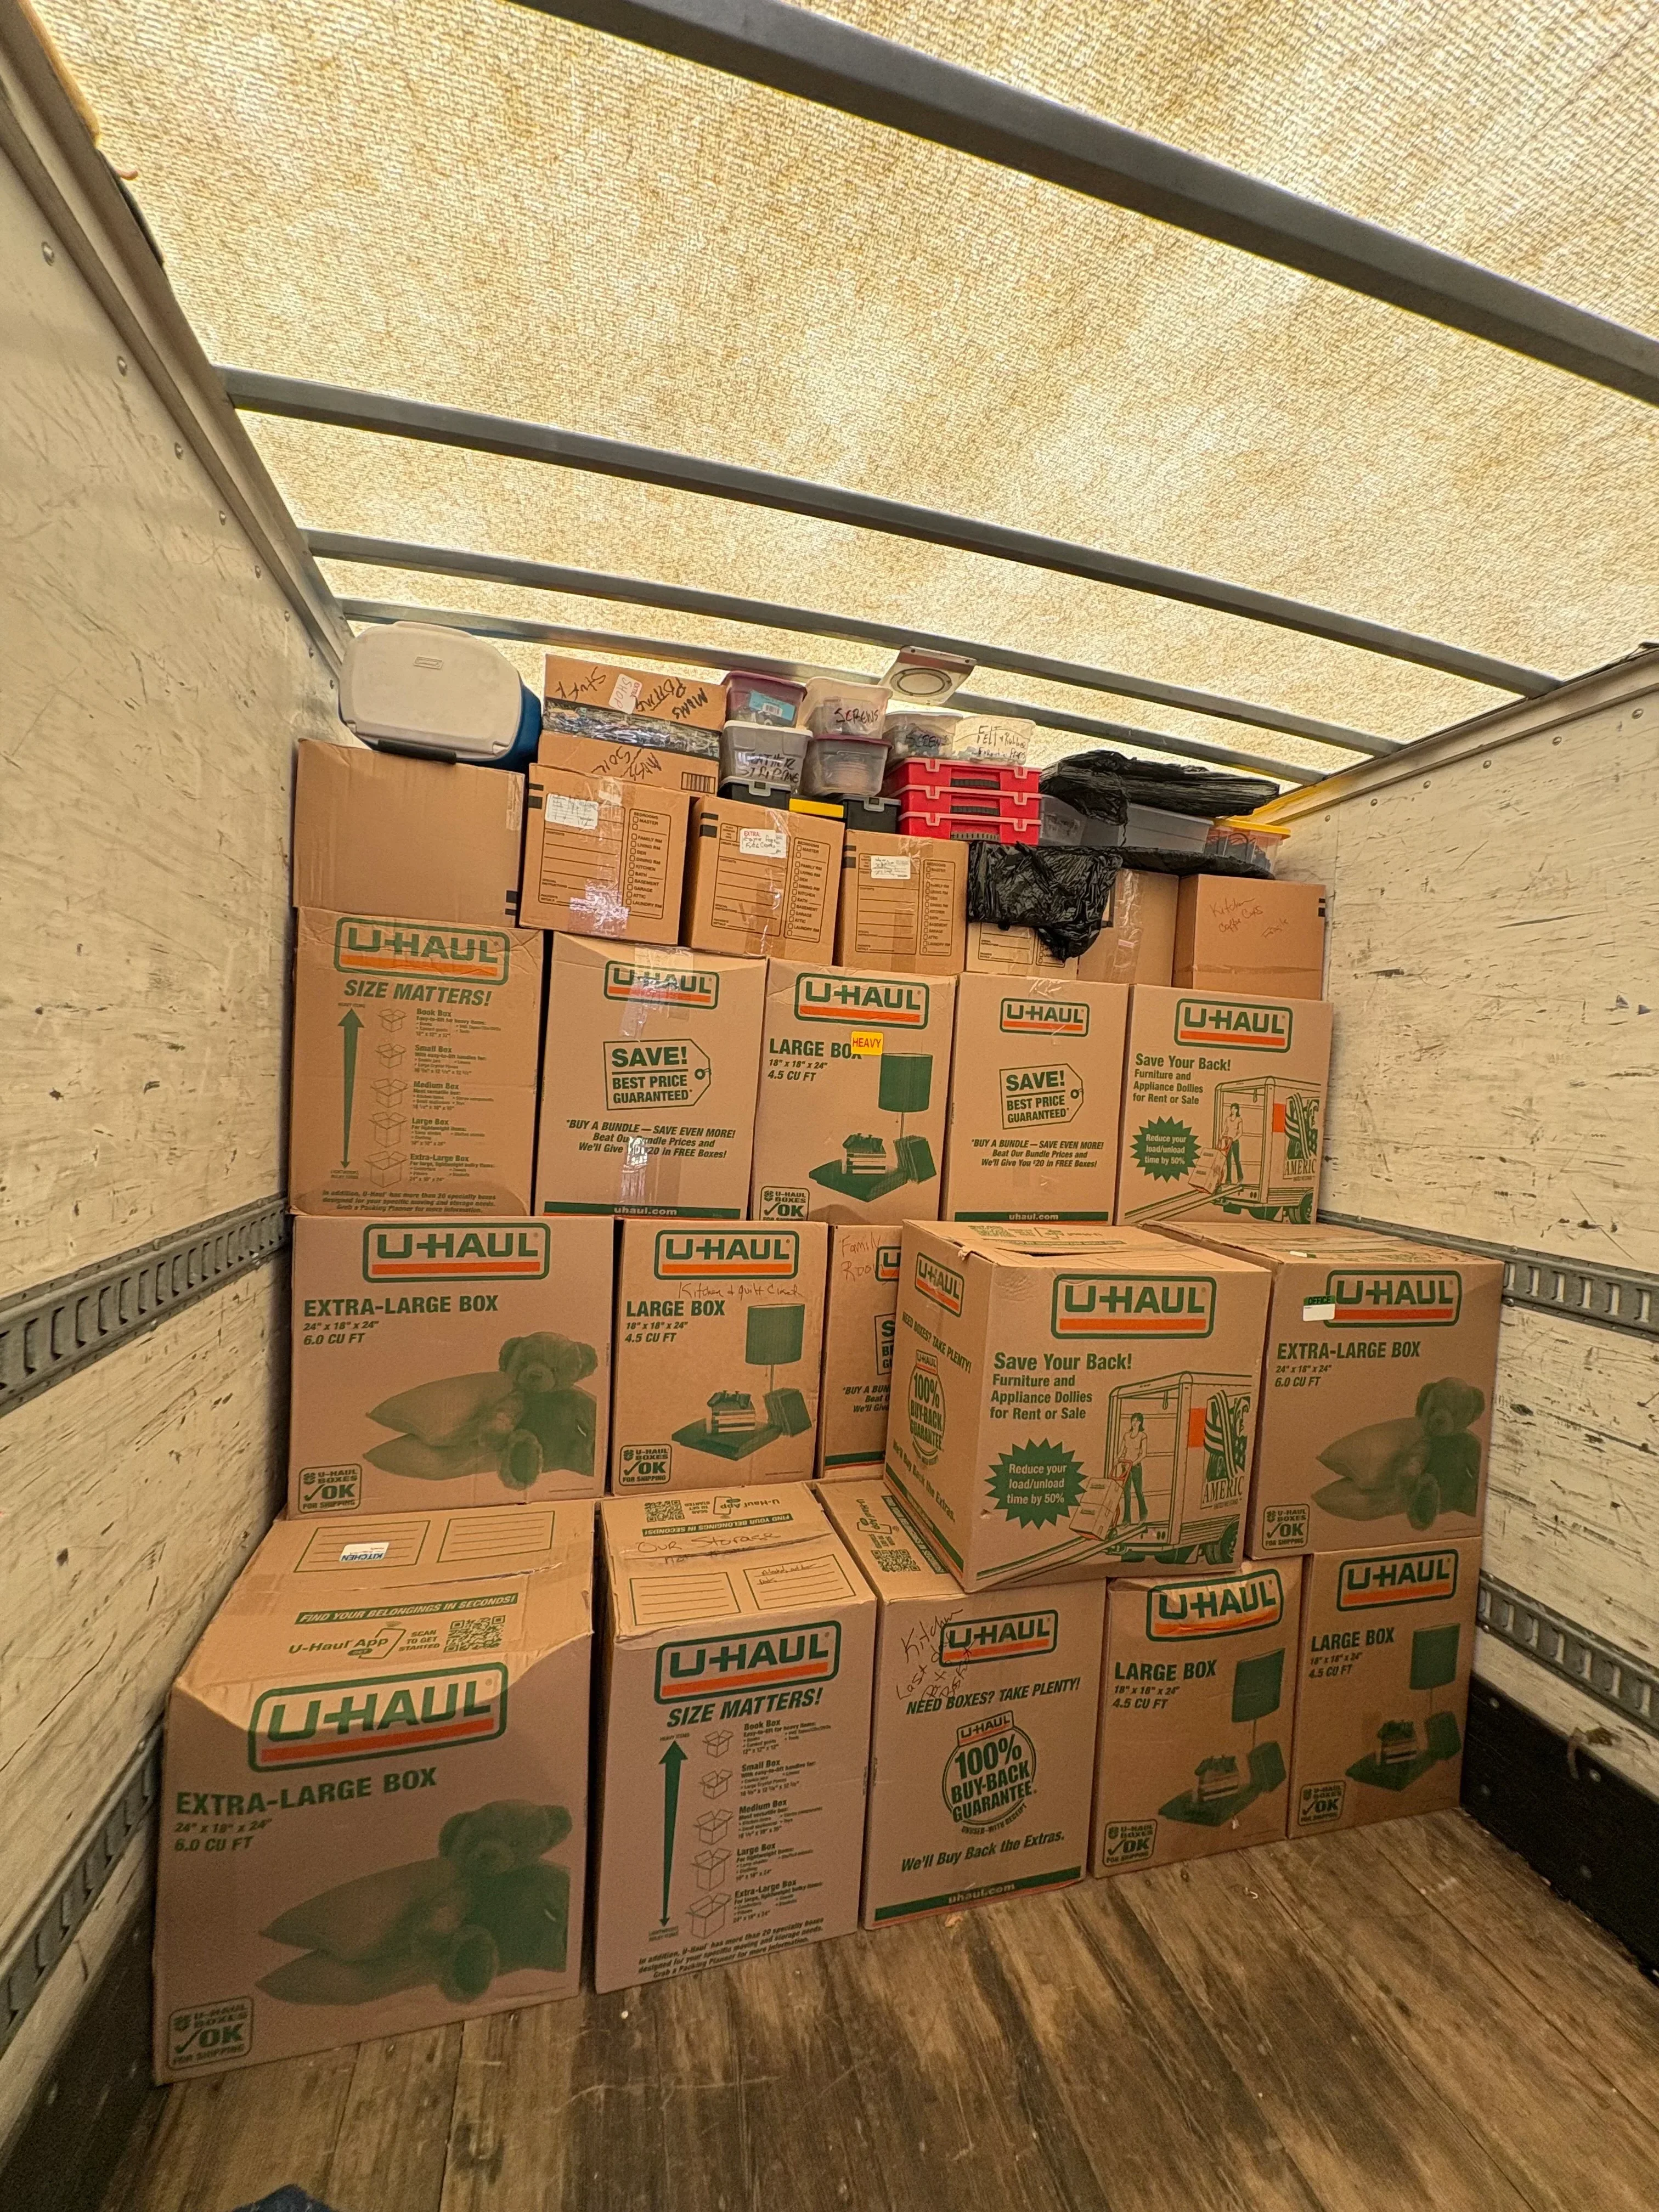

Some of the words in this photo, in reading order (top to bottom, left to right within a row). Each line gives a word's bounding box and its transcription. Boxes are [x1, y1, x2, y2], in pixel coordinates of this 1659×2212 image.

[834, 708, 878, 723] SCREWS
[348, 927, 498, 963] U-HAUL
[344, 980, 388, 997] SIZE
[393, 983, 492, 1006] MATTERS!
[805, 981, 920, 1010] U-HAUL
[1007, 1004, 1083, 1023] U-HAUL
[1184, 1007, 1284, 1034] U-HAUL
[770, 1039, 824, 1057] LARGE
[853, 1036, 882, 1048] HEAVY
[612, 1047, 687, 1067] SAVE!
[1136, 1053, 1164, 1066] Save
[1169, 1056, 1194, 1069] Your
[1199, 1058, 1231, 1071] Back!
[612, 1077, 645, 1089] BEST
[650, 1075, 687, 1087] PRICE
[1006, 1070, 1064, 1091] SAVE!
[1007, 1098, 1032, 1110] BEST
[1036, 1095, 1064, 1107] PRICE
[412, 1118, 432, 1126] Large
[410, 1154, 452, 1165] Extra-Large
[614, 1206, 676, 1215] uhaul.com
[377, 1233, 538, 1259] U-HAUL
[666, 1239, 789, 1260] U-HAUL
[918, 1260, 959, 1299] U-HAUL
[1065, 1285, 1205, 1313] U-HAUL
[1308, 1296, 1331, 1305] OFFICE
[1335, 1280, 1453, 1305] U-HAUL
[304, 1296, 450, 1317] EXTRA-LARGE
[460, 1295, 498, 1311] BOX
[627, 1301, 684, 1317] LARGE
[691, 1300, 725, 1316] BOX
[304, 1335, 324, 1345] 6.0
[328, 1334, 345, 1344] CU
[349, 1333, 365, 1343] FT
[1277, 1342, 1386, 1359] EXTRA-LARGE
[1391, 1341, 1420, 1357] BOX
[994, 1352, 1037, 1370] Save
[1043, 1354, 1080, 1370] Your
[1087, 1353, 1131, 1369] Back!
[993, 1374, 1049, 1387] Furniture
[1054, 1375, 1075, 1386] and
[991, 1390, 1051, 1405] Appliance
[1055, 1391, 1092, 1402] Dollies
[990, 1407, 1008, 1418] for
[1013, 1408, 1041, 1420] Rent
[1045, 1410, 1057, 1419] or
[1061, 1408, 1086, 1419] Sale
[318, 1469, 357, 1477] U-HAUL
[318, 1475, 357, 1483] BOXES
[1009, 1464, 1044, 1474] Reduce
[1047, 1465, 1066, 1475] your
[321, 1483, 354, 1499] OK
[1009, 1478, 1064, 1489] load/unload
[319, 1499, 355, 1508] SHIPPING
[1007, 1494, 1028, 1504] time
[1031, 1494, 1042, 1505] by
[1045, 1493, 1064, 1503] 50%
[341, 1552, 384, 1562] KITCHEN
[1347, 1559, 1449, 1590] U-HAUL
[300, 1613, 330, 1622] FIND
[334, 1611, 365, 1620] YOUR
[366, 1604, 441, 1617] BELONGINGS
[459, 1595, 515, 1609] SECONDS!
[1159, 1580, 1276, 1620] U-HAUL
[353, 1639, 388, 1647] App
[946, 1618, 1049, 1652] U-HAUL
[1311, 1632, 1360, 1651] LARGE
[1366, 1628, 1393, 1646] BOX
[670, 1634, 828, 1678] U-HAUL
[1115, 1662, 1177, 1681] LARGE
[1184, 1660, 1217, 1680] BOX
[906, 1698, 941, 1714] NEED
[946, 1692, 993, 1709] BOXES?
[1000, 1685, 1029, 1702] TAKE
[1032, 1677, 1080, 1696] PLENTY!
[267, 1680, 491, 1742] U-HAUL
[667, 1703, 715, 1727] SIZE
[720, 1688, 823, 1719] MATTERS!
[961, 1716, 1010, 1738] U-HAUL
[955, 1734, 1022, 1779] 100%
[951, 1752, 1031, 1805] BUY-BACK
[176, 1777, 371, 1816] EXTRA-LARGE
[383, 1768, 436, 1793] BOX
[902, 1854, 934, 1872] We'll
[937, 1852, 962, 1865] Buy
[964, 1843, 996, 1860] Back
[1000, 1839, 1020, 1852] the
[1024, 1831, 1064, 1848] Extras.
[949, 1884, 1014, 1903] uhaul.com
